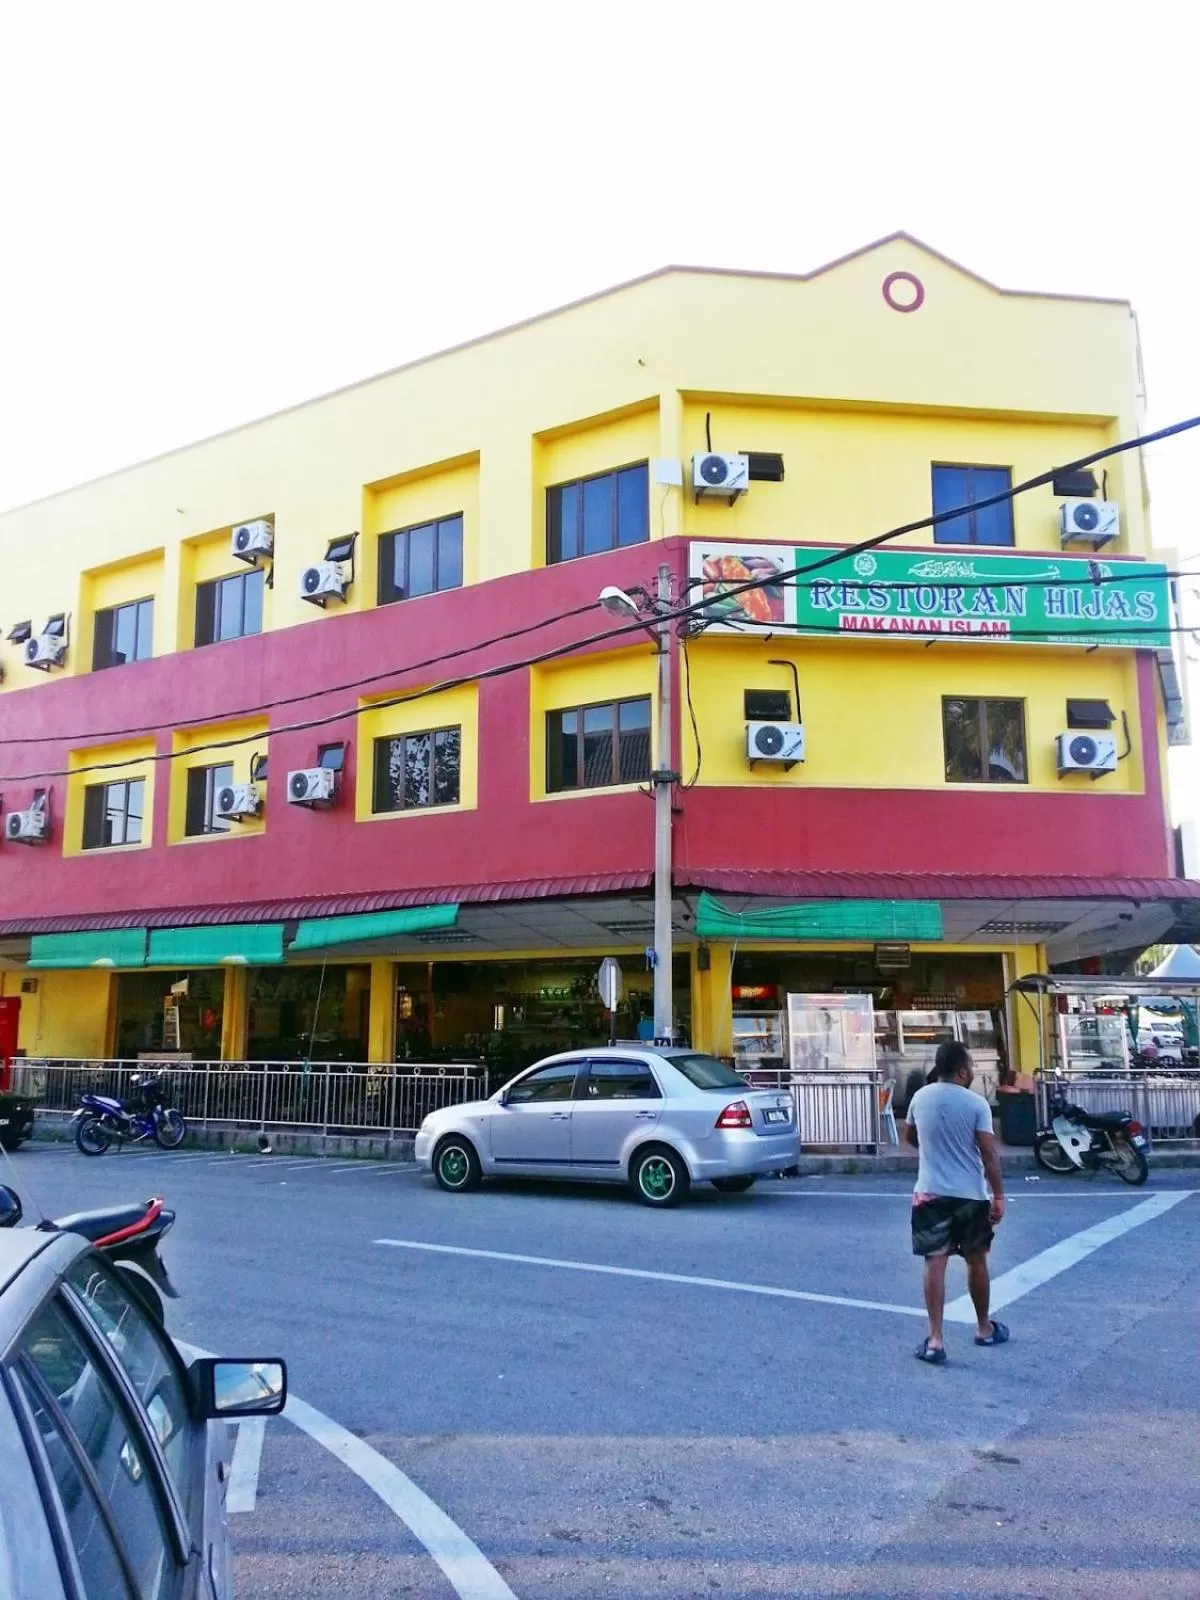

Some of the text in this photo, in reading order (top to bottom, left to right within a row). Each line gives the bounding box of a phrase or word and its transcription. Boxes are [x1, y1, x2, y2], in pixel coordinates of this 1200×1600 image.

[811, 577, 1158, 621] RESTORAN HIJAS
[842, 615, 1008, 637] MAKANAN ISLAM
